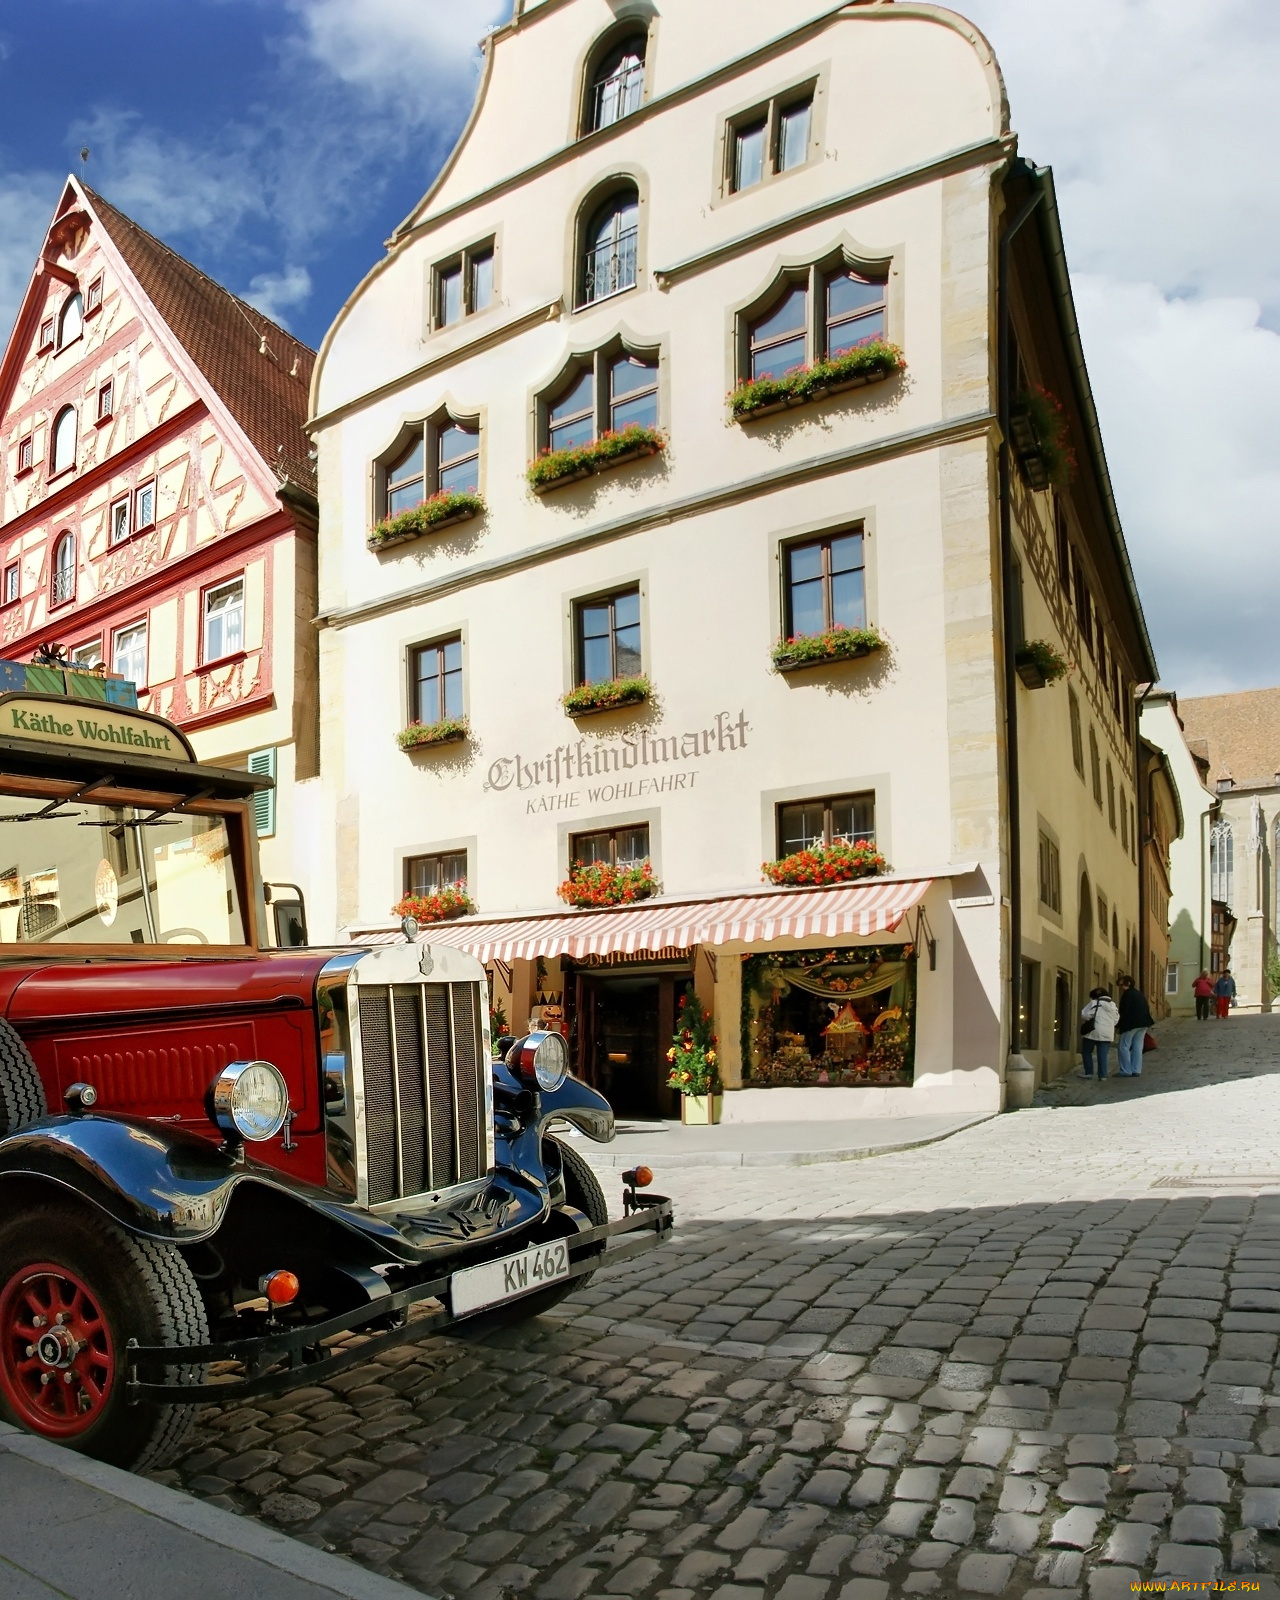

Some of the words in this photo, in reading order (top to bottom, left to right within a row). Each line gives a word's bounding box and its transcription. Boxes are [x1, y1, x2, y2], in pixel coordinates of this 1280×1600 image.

[11, 709, 74, 737] Käthe
[77, 719, 171, 751] Wohlfahrt
[482, 708, 753, 793] Christkindlmarkt
[587, 771, 700, 803] WOHLFAHRT
[503, 1256, 528, 1293] KW
[532, 1245, 567, 1280] 462
